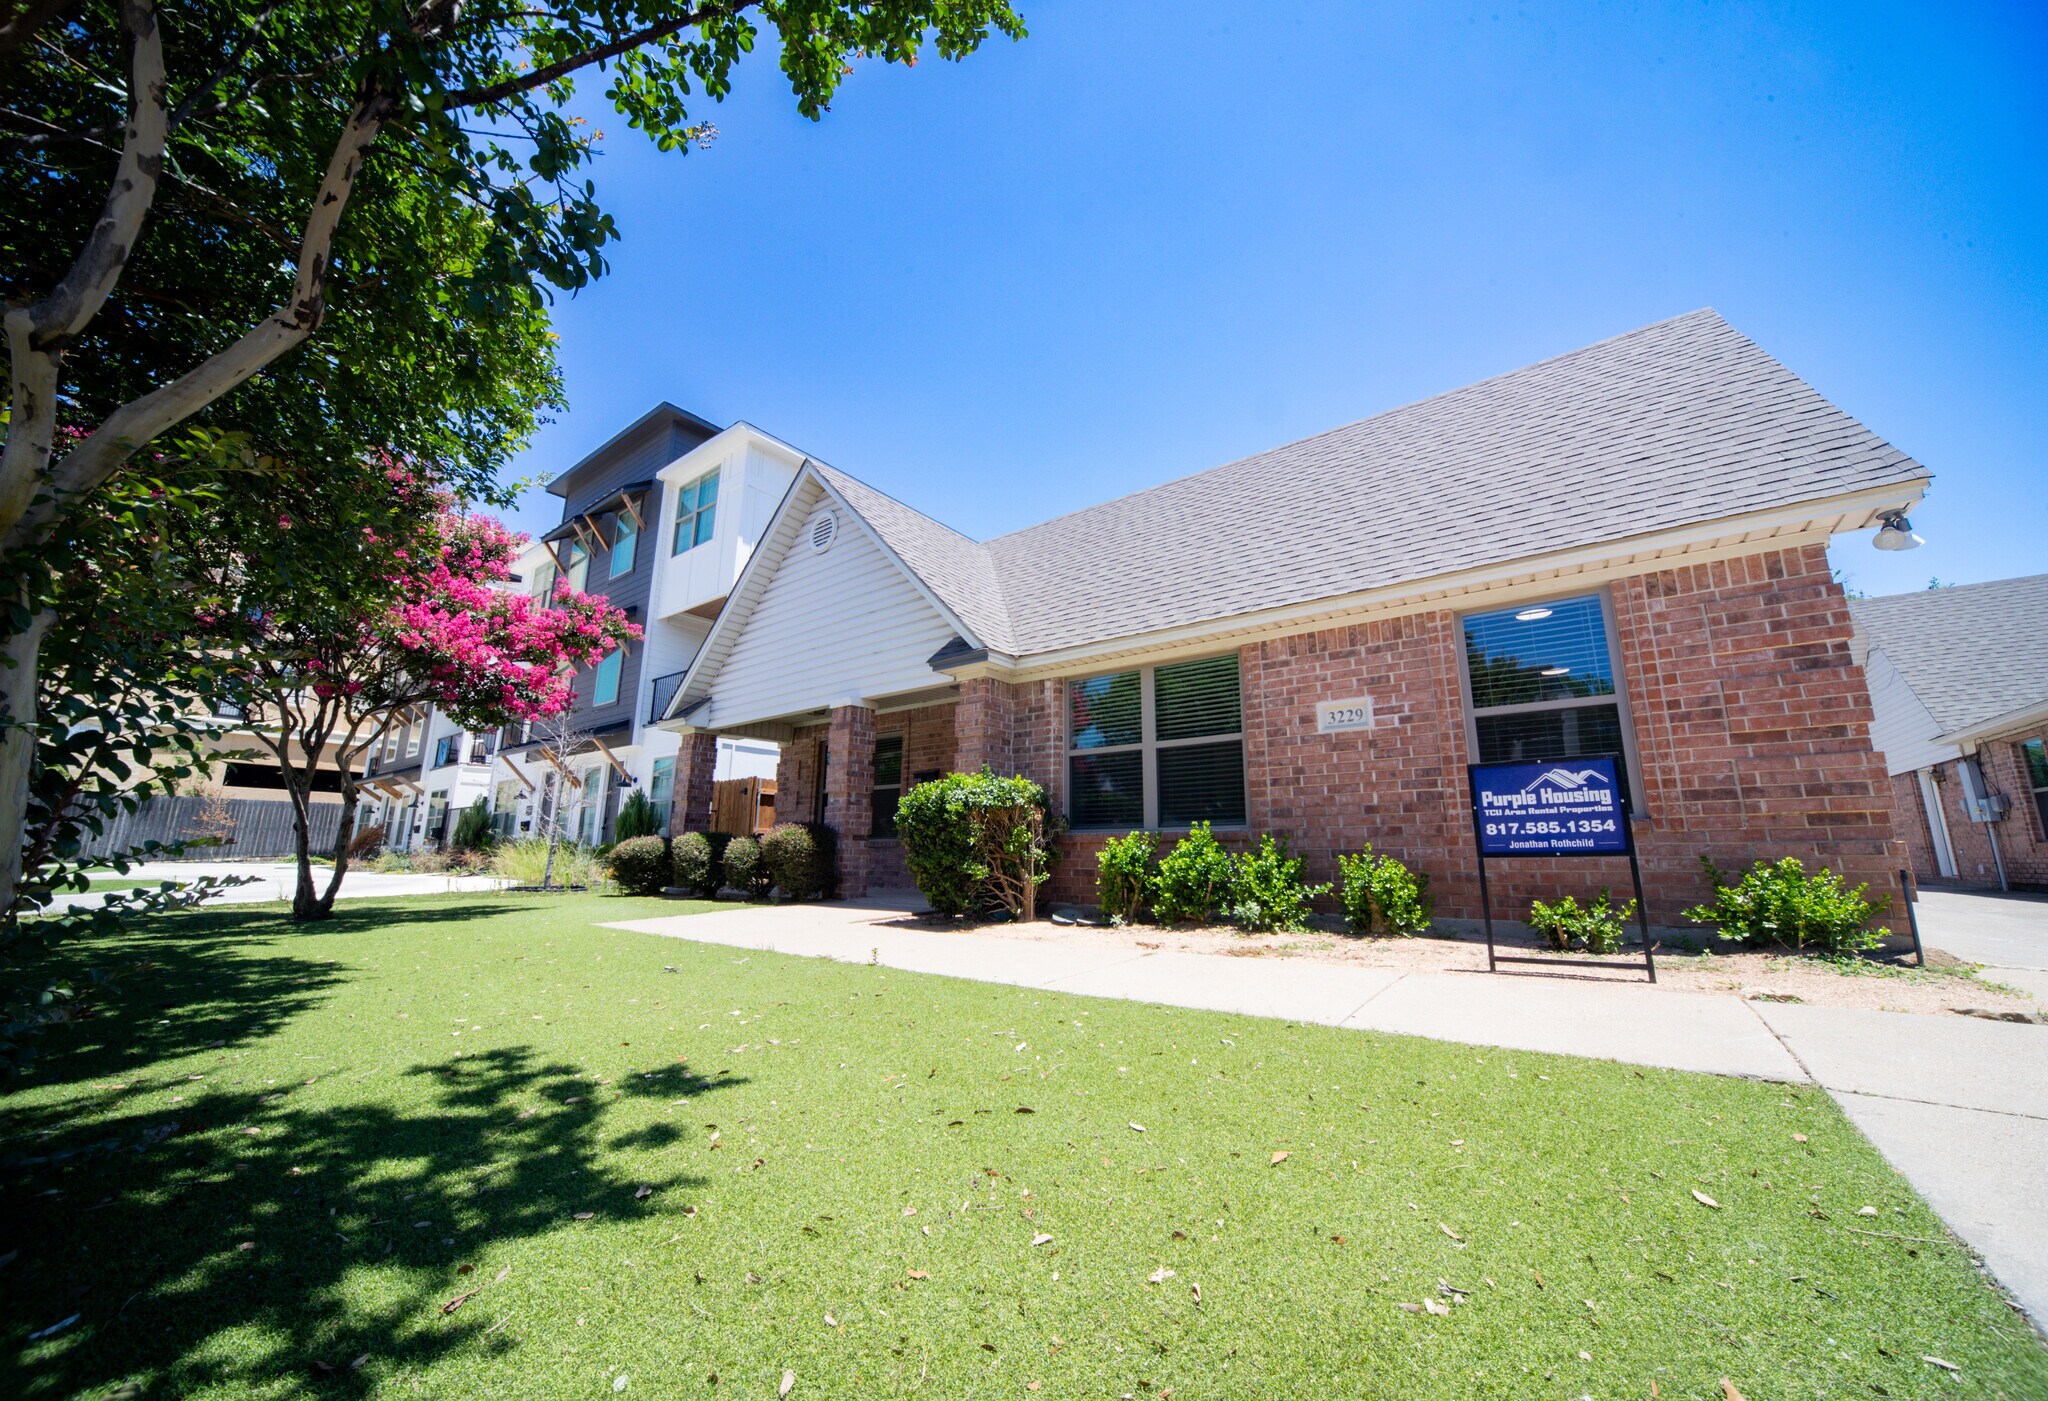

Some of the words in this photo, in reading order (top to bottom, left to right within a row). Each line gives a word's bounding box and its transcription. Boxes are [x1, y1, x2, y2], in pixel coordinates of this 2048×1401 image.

[1328, 708, 1364, 725] 3229
[1481, 789, 1537, 809] Purple
[1540, 787, 1613, 805] Housing
[1504, 808, 1527, 816] Area
[1528, 806, 1558, 815] Rental
[1559, 804, 1614, 814] Properties
[1486, 819, 1616, 835] 817.585.1354
[1509, 840, 1549, 849] Jonathan
[1550, 838, 1594, 848] Rothchild
